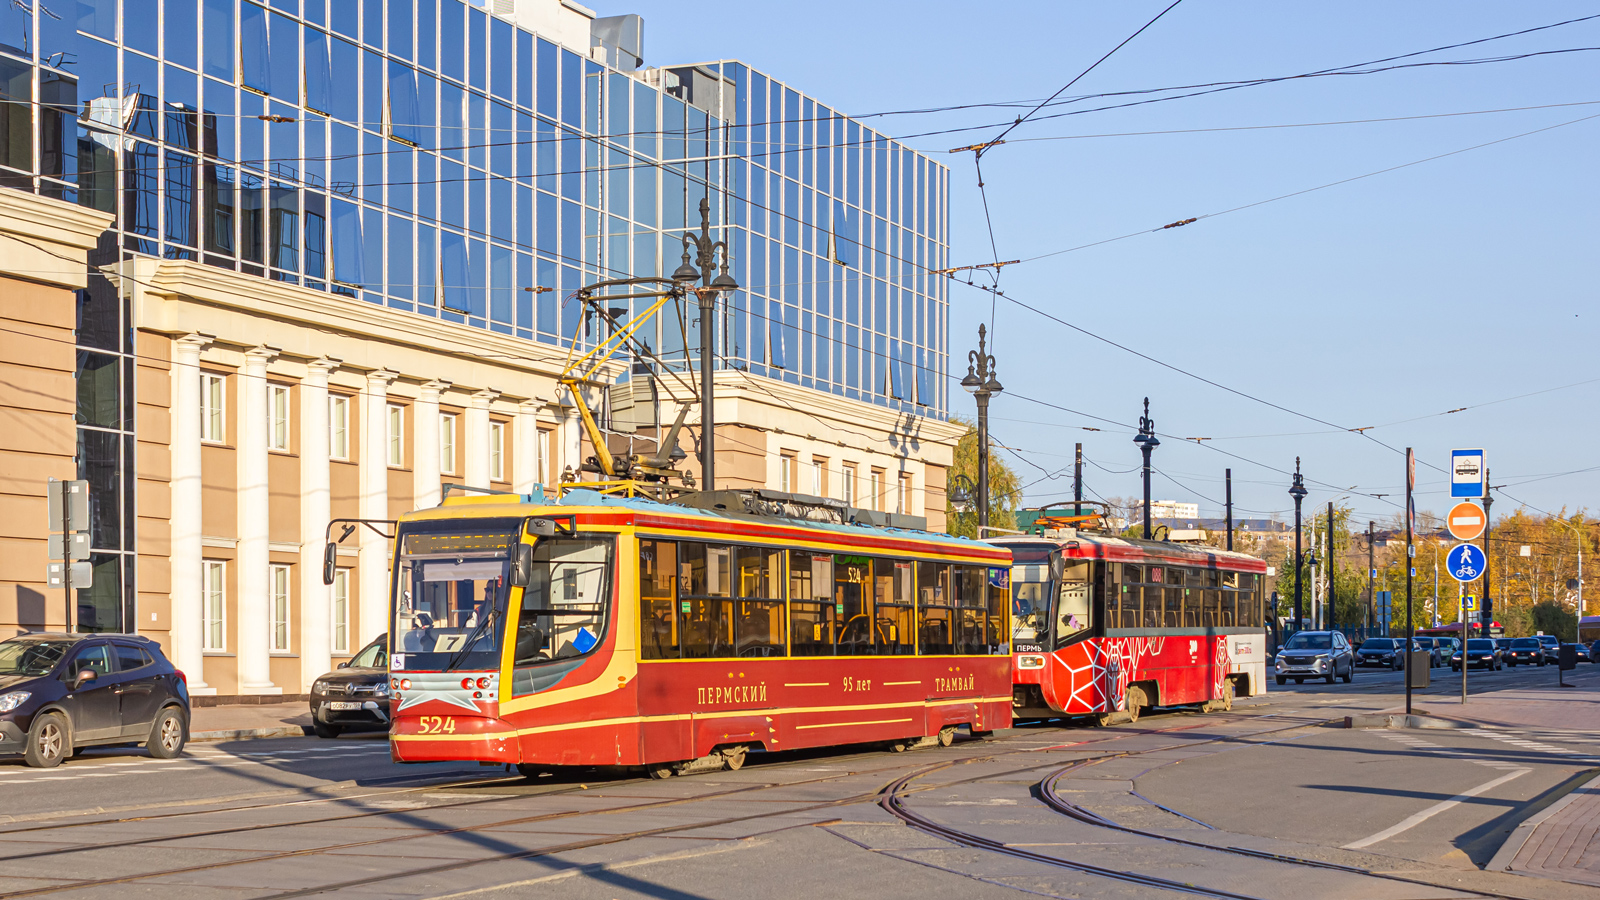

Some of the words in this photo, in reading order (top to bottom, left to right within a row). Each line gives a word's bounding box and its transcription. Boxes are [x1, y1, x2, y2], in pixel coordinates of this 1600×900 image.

[848, 567, 860, 583] 524
[1151, 567, 1162, 583] 088
[446, 636, 460, 651] 7
[1016, 644, 1042, 652] ПЕРМЬ
[843, 676, 853, 692] 95
[856, 679, 871, 691] лет
[935, 673, 974, 692] ТРАМВАЙ
[697, 681, 767, 705] ПЕРМСКИЙ
[417, 715, 456, 734] 524
